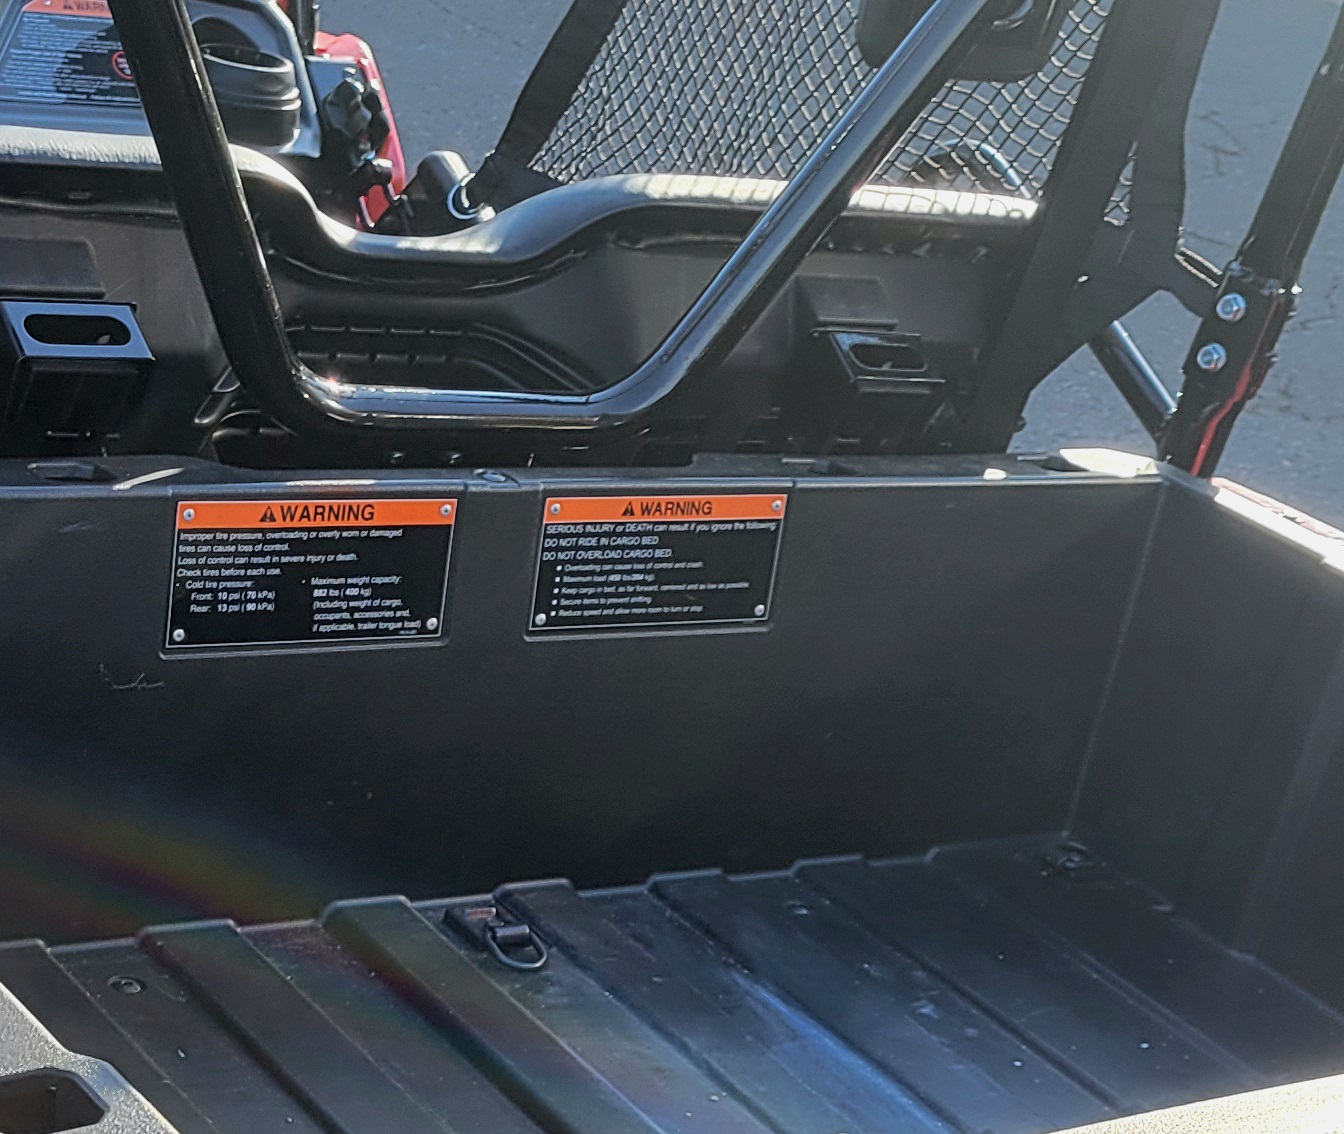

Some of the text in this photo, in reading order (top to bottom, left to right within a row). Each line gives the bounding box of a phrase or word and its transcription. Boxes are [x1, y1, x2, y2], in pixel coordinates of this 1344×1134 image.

[280, 504, 375, 522] WARNING
[640, 502, 712, 516] WARNING
[546, 525, 584, 534] SERIOUS
[585, 525, 615, 533] INJURY
[625, 524, 653, 532] DEATH
[696, 524, 710, 533] you
[180, 532, 214, 542] Improper
[266, 531, 308, 540] overloading
[544, 536, 659, 547] DO NOT RIDE IN CARGO BED
[254, 543, 263, 551] of
[543, 552, 556, 560] DO
[557, 551, 575, 560] NOT
[577, 550, 622, 559] OVERLOAD
[623, 549, 653, 558] CARGO
[178, 557, 196, 565] Loss
[198, 556, 206, 564] of
[177, 568, 201, 576] Check
[221, 568, 245, 576] before
[186, 580, 204, 589] Cold
[218, 592, 227, 600] 10
